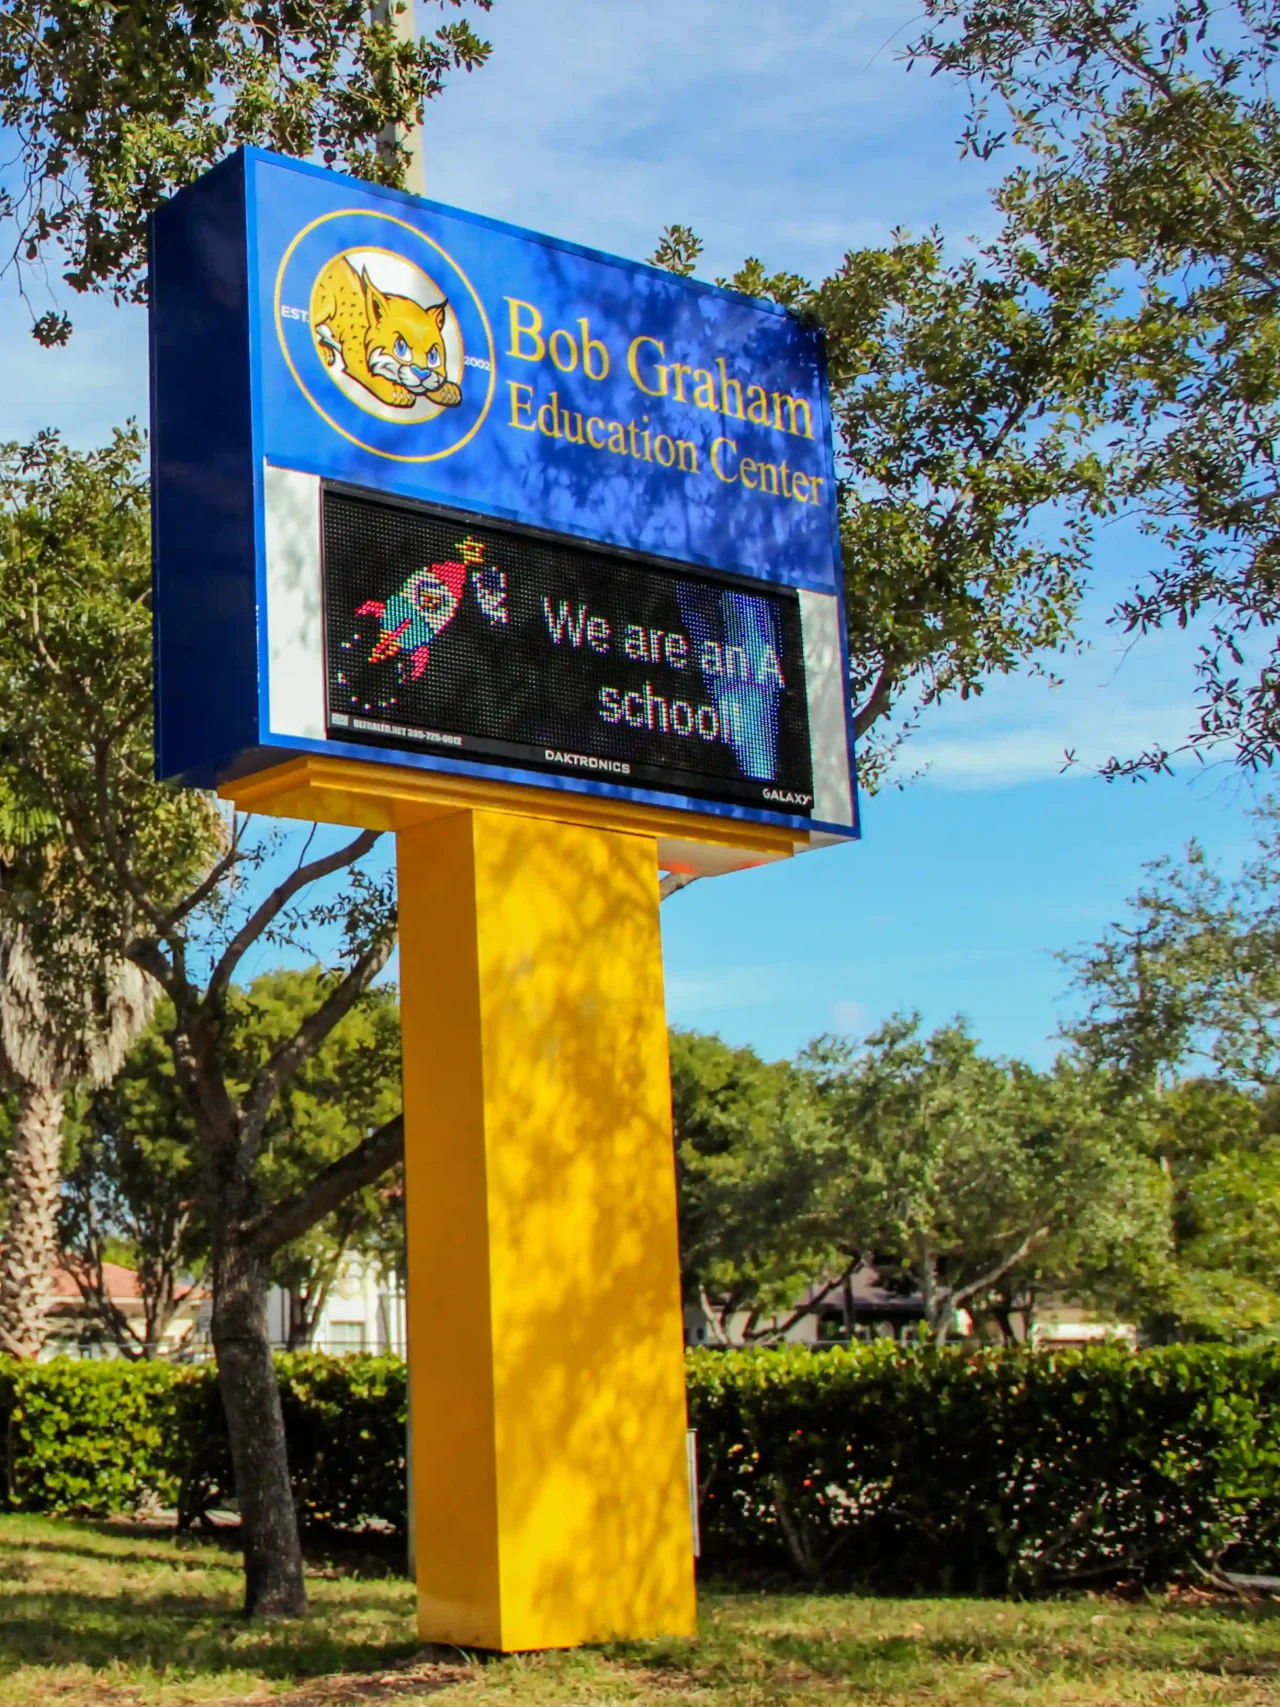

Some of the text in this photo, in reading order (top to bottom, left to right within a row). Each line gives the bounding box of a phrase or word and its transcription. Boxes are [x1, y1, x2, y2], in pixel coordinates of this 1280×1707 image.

[464, 355, 491, 372] 2002
[503, 296, 815, 440] Bob Graham
[505, 380, 824, 506] Education Center
[540, 595, 612, 653] We
[624, 623, 689, 669] are
[699, 641, 750, 683] an
[544, 749, 631, 775] DAKTRONICS
[762, 787, 813, 806] GALAXY
